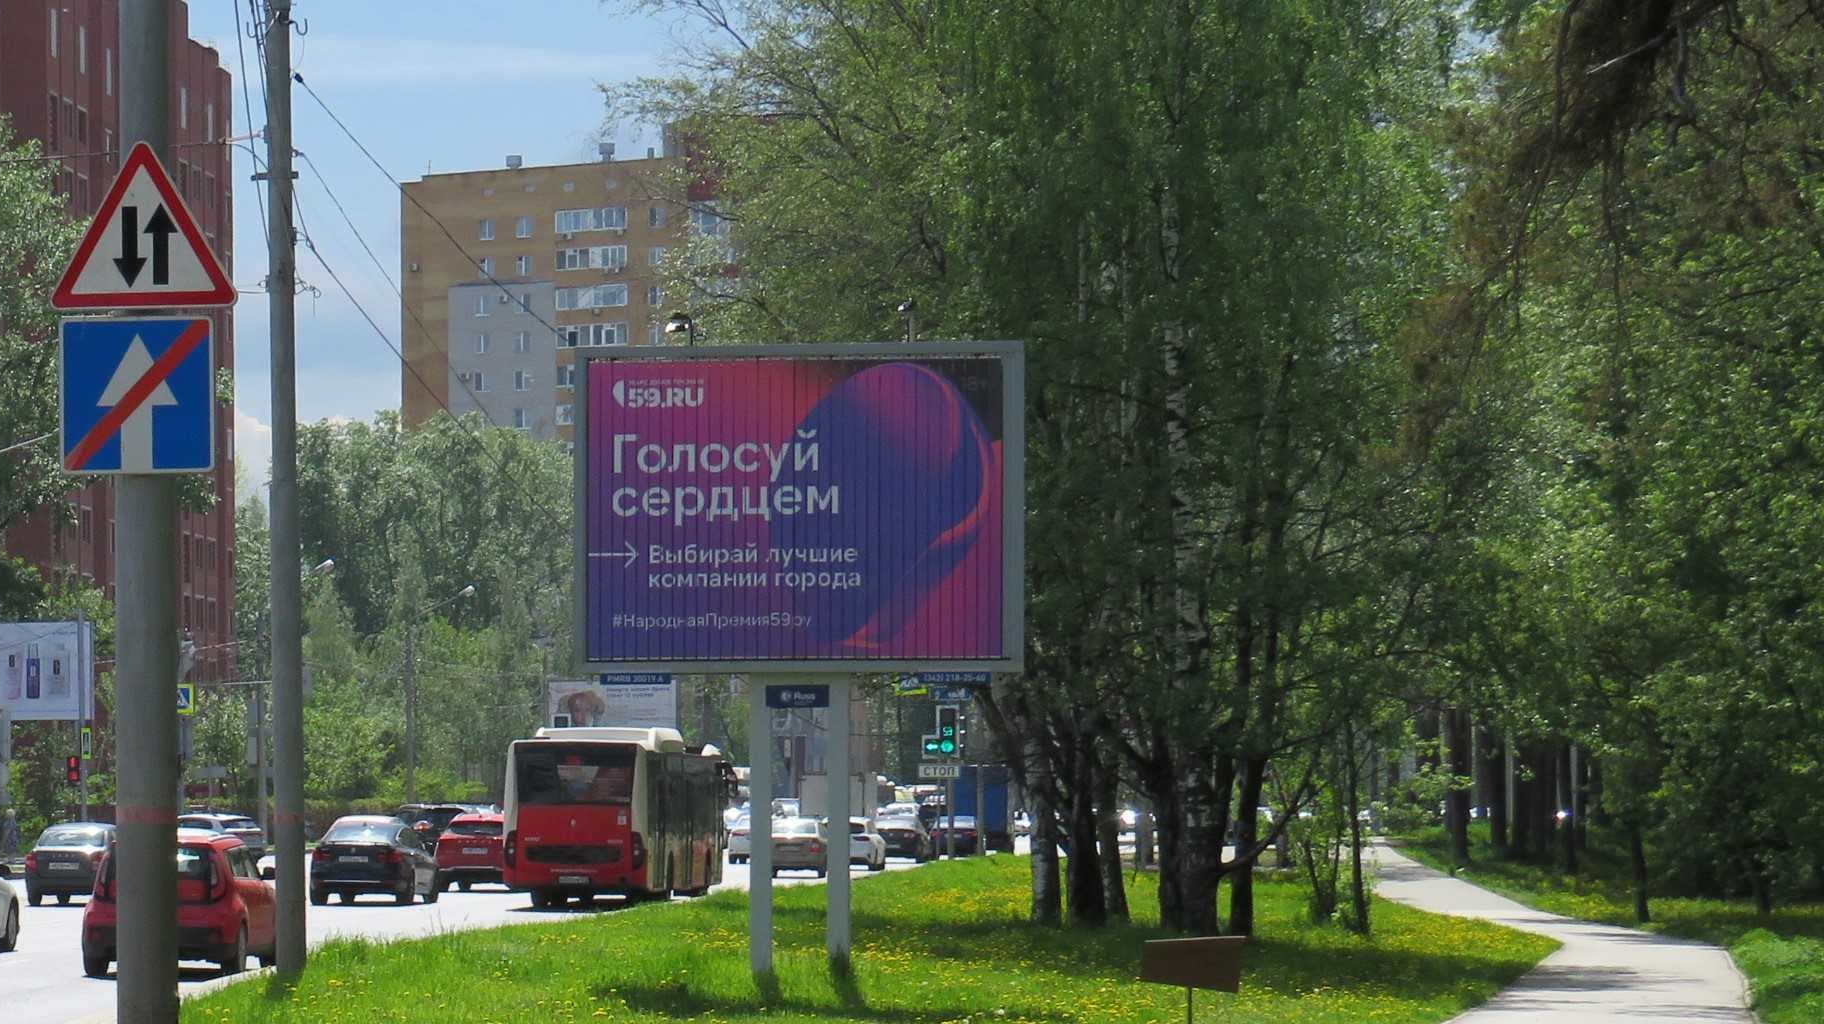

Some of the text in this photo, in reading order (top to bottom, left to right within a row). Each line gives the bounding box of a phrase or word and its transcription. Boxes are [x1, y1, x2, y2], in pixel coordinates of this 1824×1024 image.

[628, 387, 705, 408] 59.RU
[613, 429, 820, 482] Голосуй
[612, 485, 840, 526] сердцем
[648, 543, 859, 569] Выбирай лучшие
[648, 571, 862, 591] компании города
[923, 767, 955, 777] СТОП
